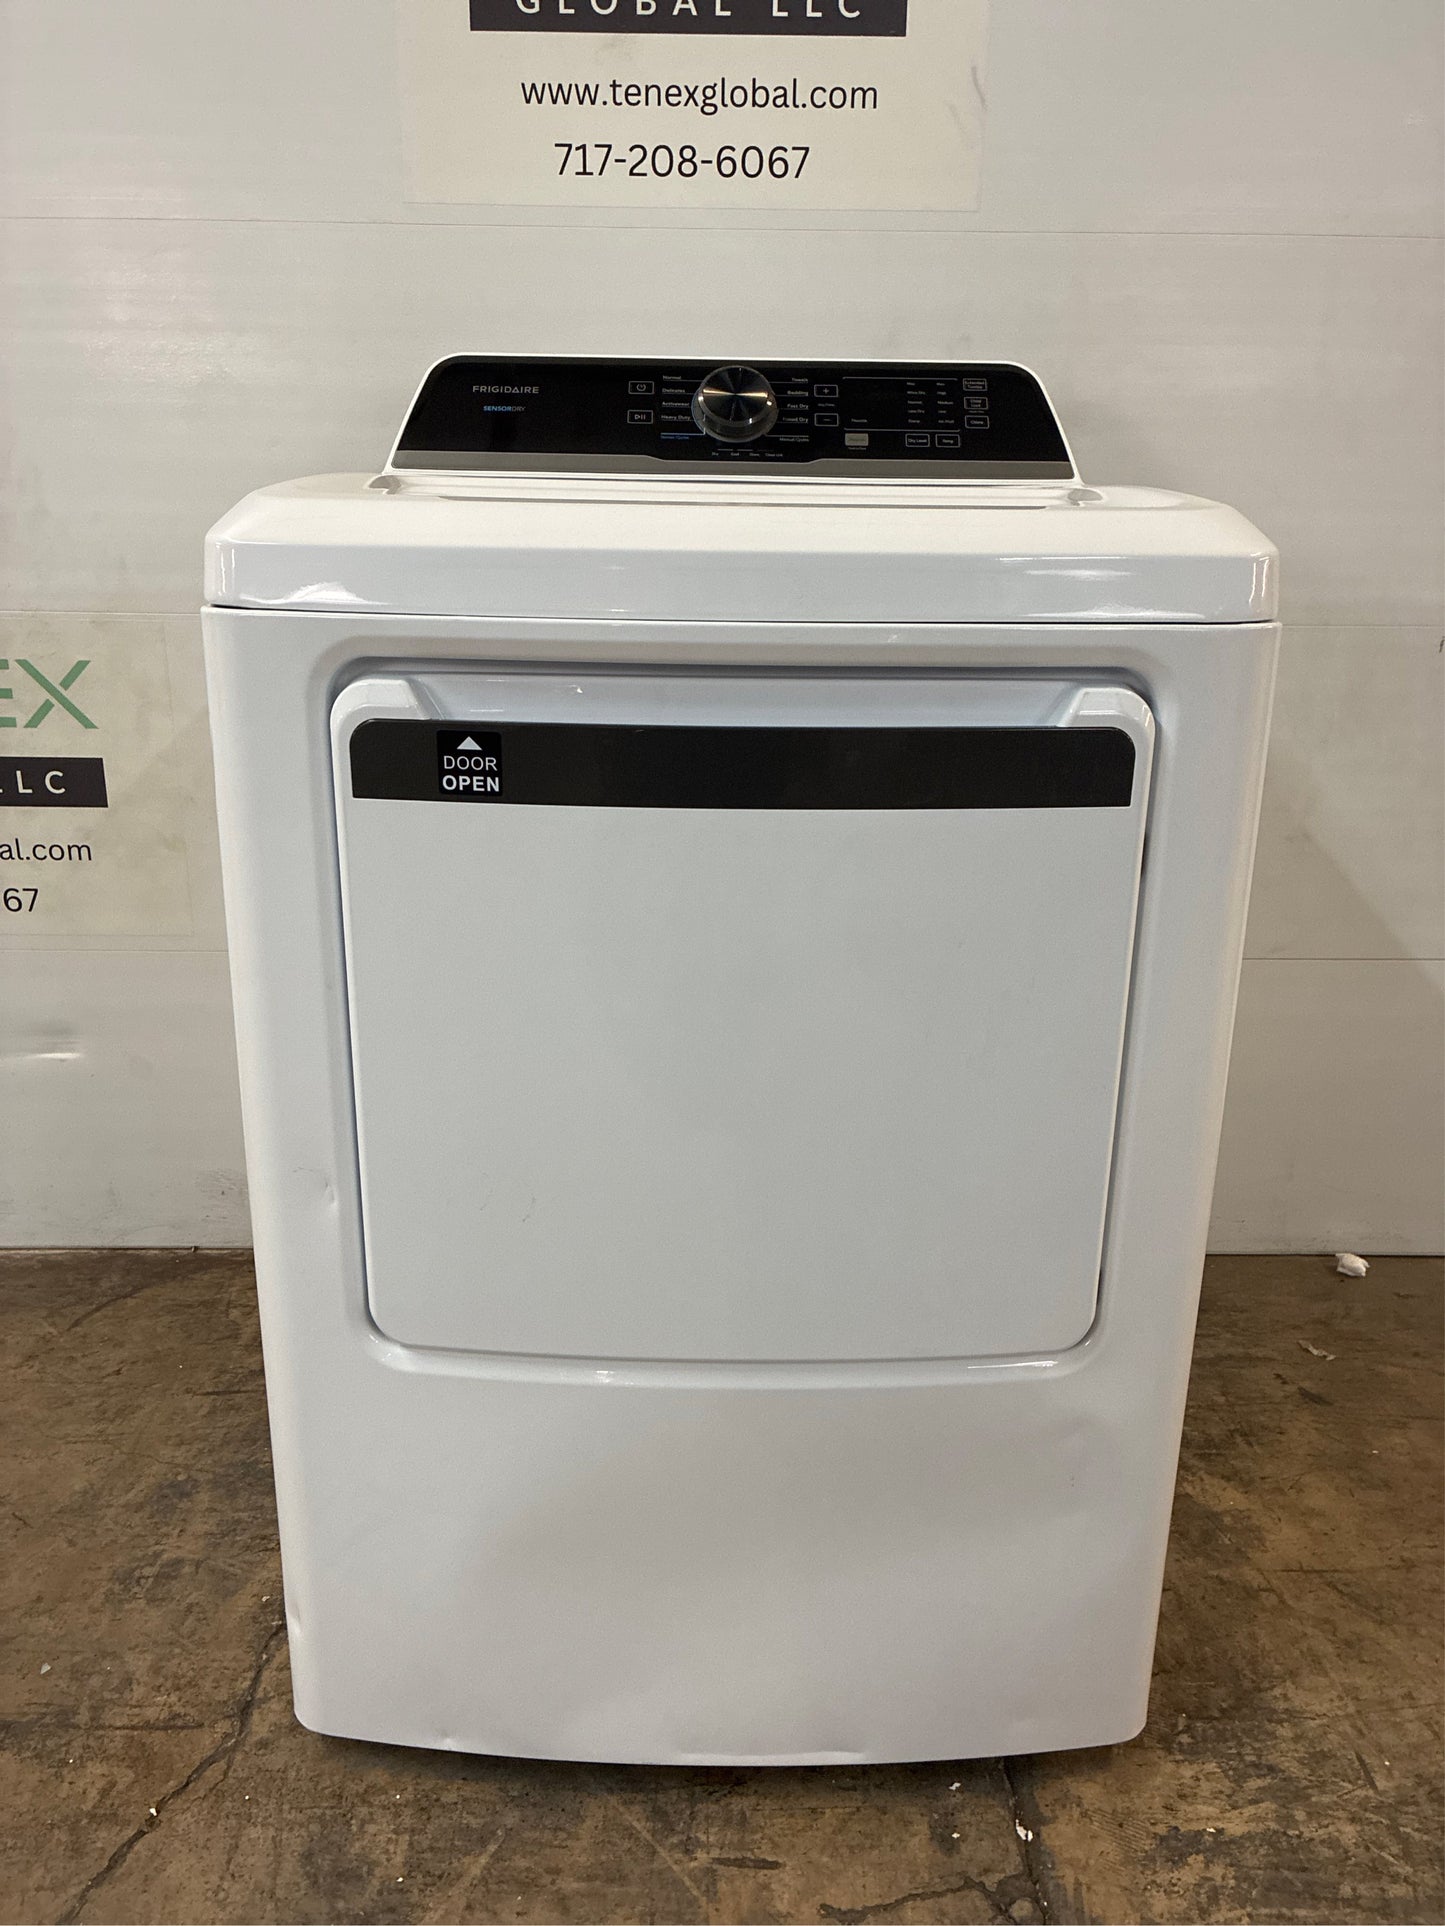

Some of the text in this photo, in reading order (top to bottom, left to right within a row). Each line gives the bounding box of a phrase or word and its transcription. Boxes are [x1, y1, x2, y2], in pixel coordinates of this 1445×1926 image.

[521, 78, 878, 116] www.tenexglobal.com
[554, 143, 810, 178] 717-208-6067
[472, 385, 540, 394] FRIGIDAIRE
[443, 755, 498, 771] DOOR
[442, 775, 500, 792] OPEN
